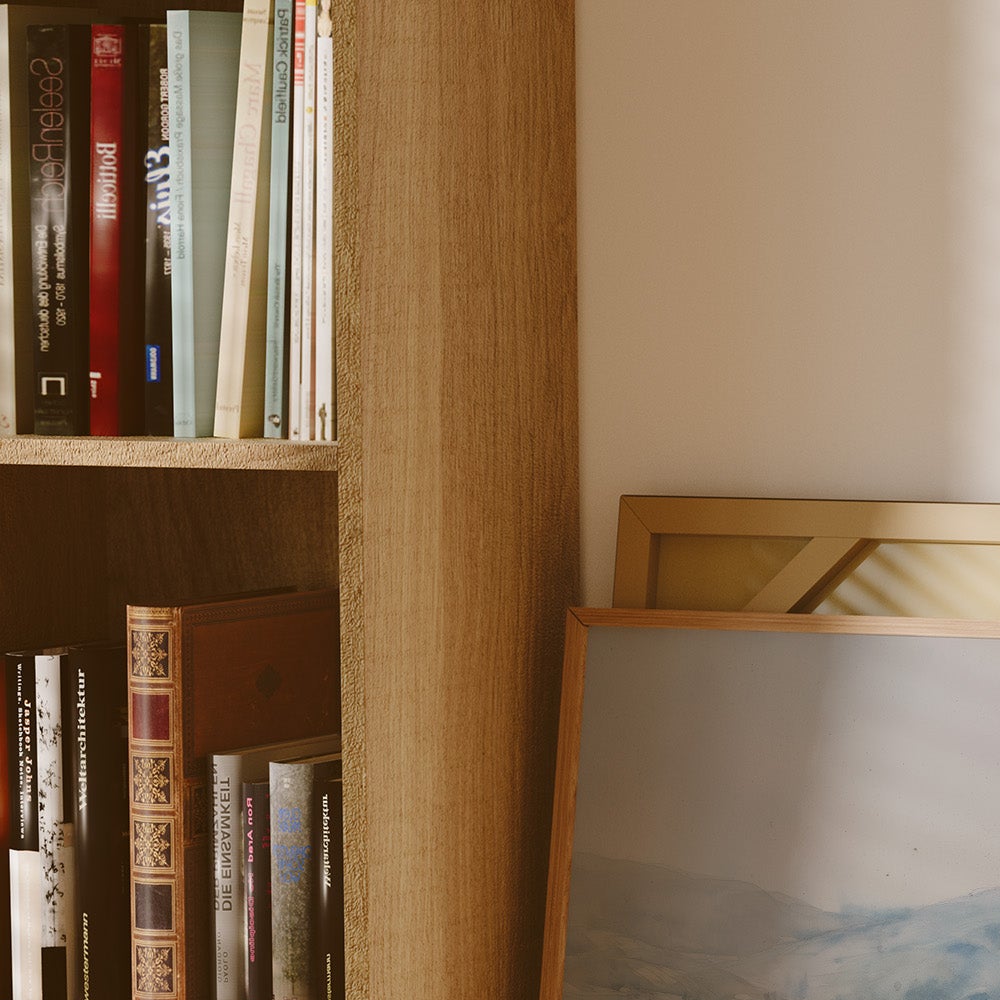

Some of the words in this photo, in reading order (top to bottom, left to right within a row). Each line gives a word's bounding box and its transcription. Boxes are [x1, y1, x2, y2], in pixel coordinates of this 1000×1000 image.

[23, 699, 32, 752] Jasper
[78, 669, 86, 811] Weltarchitektur
[24, 755, 33, 803] Johns
